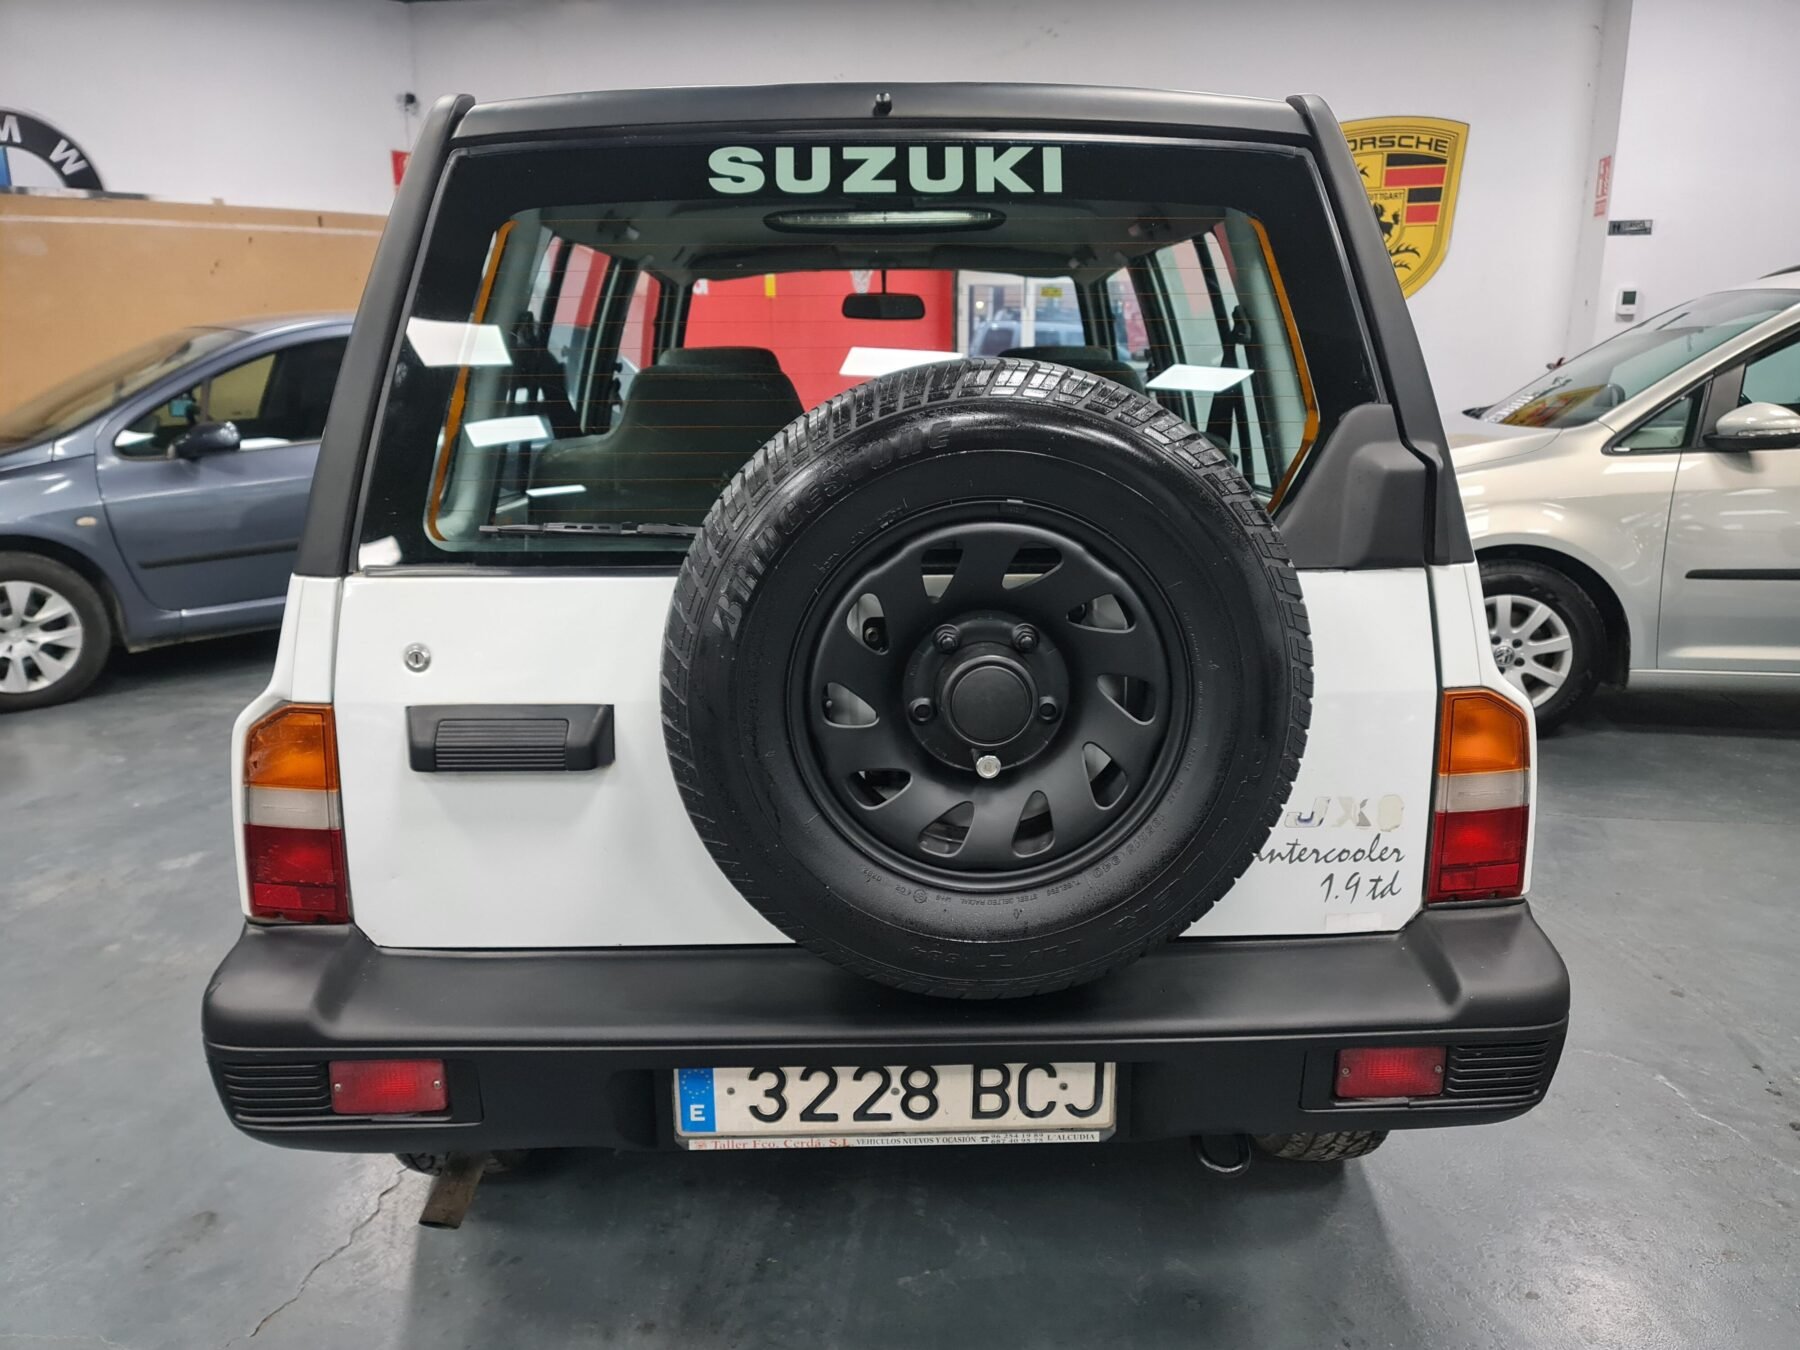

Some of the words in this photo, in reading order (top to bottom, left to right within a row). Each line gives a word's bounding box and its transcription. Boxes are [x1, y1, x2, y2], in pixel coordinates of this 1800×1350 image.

[708, 146, 1063, 194] SUZUKI
[1320, 872, 1361, 904] 1.9
[1366, 870, 1402, 901] td
[690, 1104, 706, 1122] E
[749, 1064, 938, 1123] 3228
[972, 1062, 1104, 1119] BCJ
[902, 1137, 934, 1145] NUEVOS
